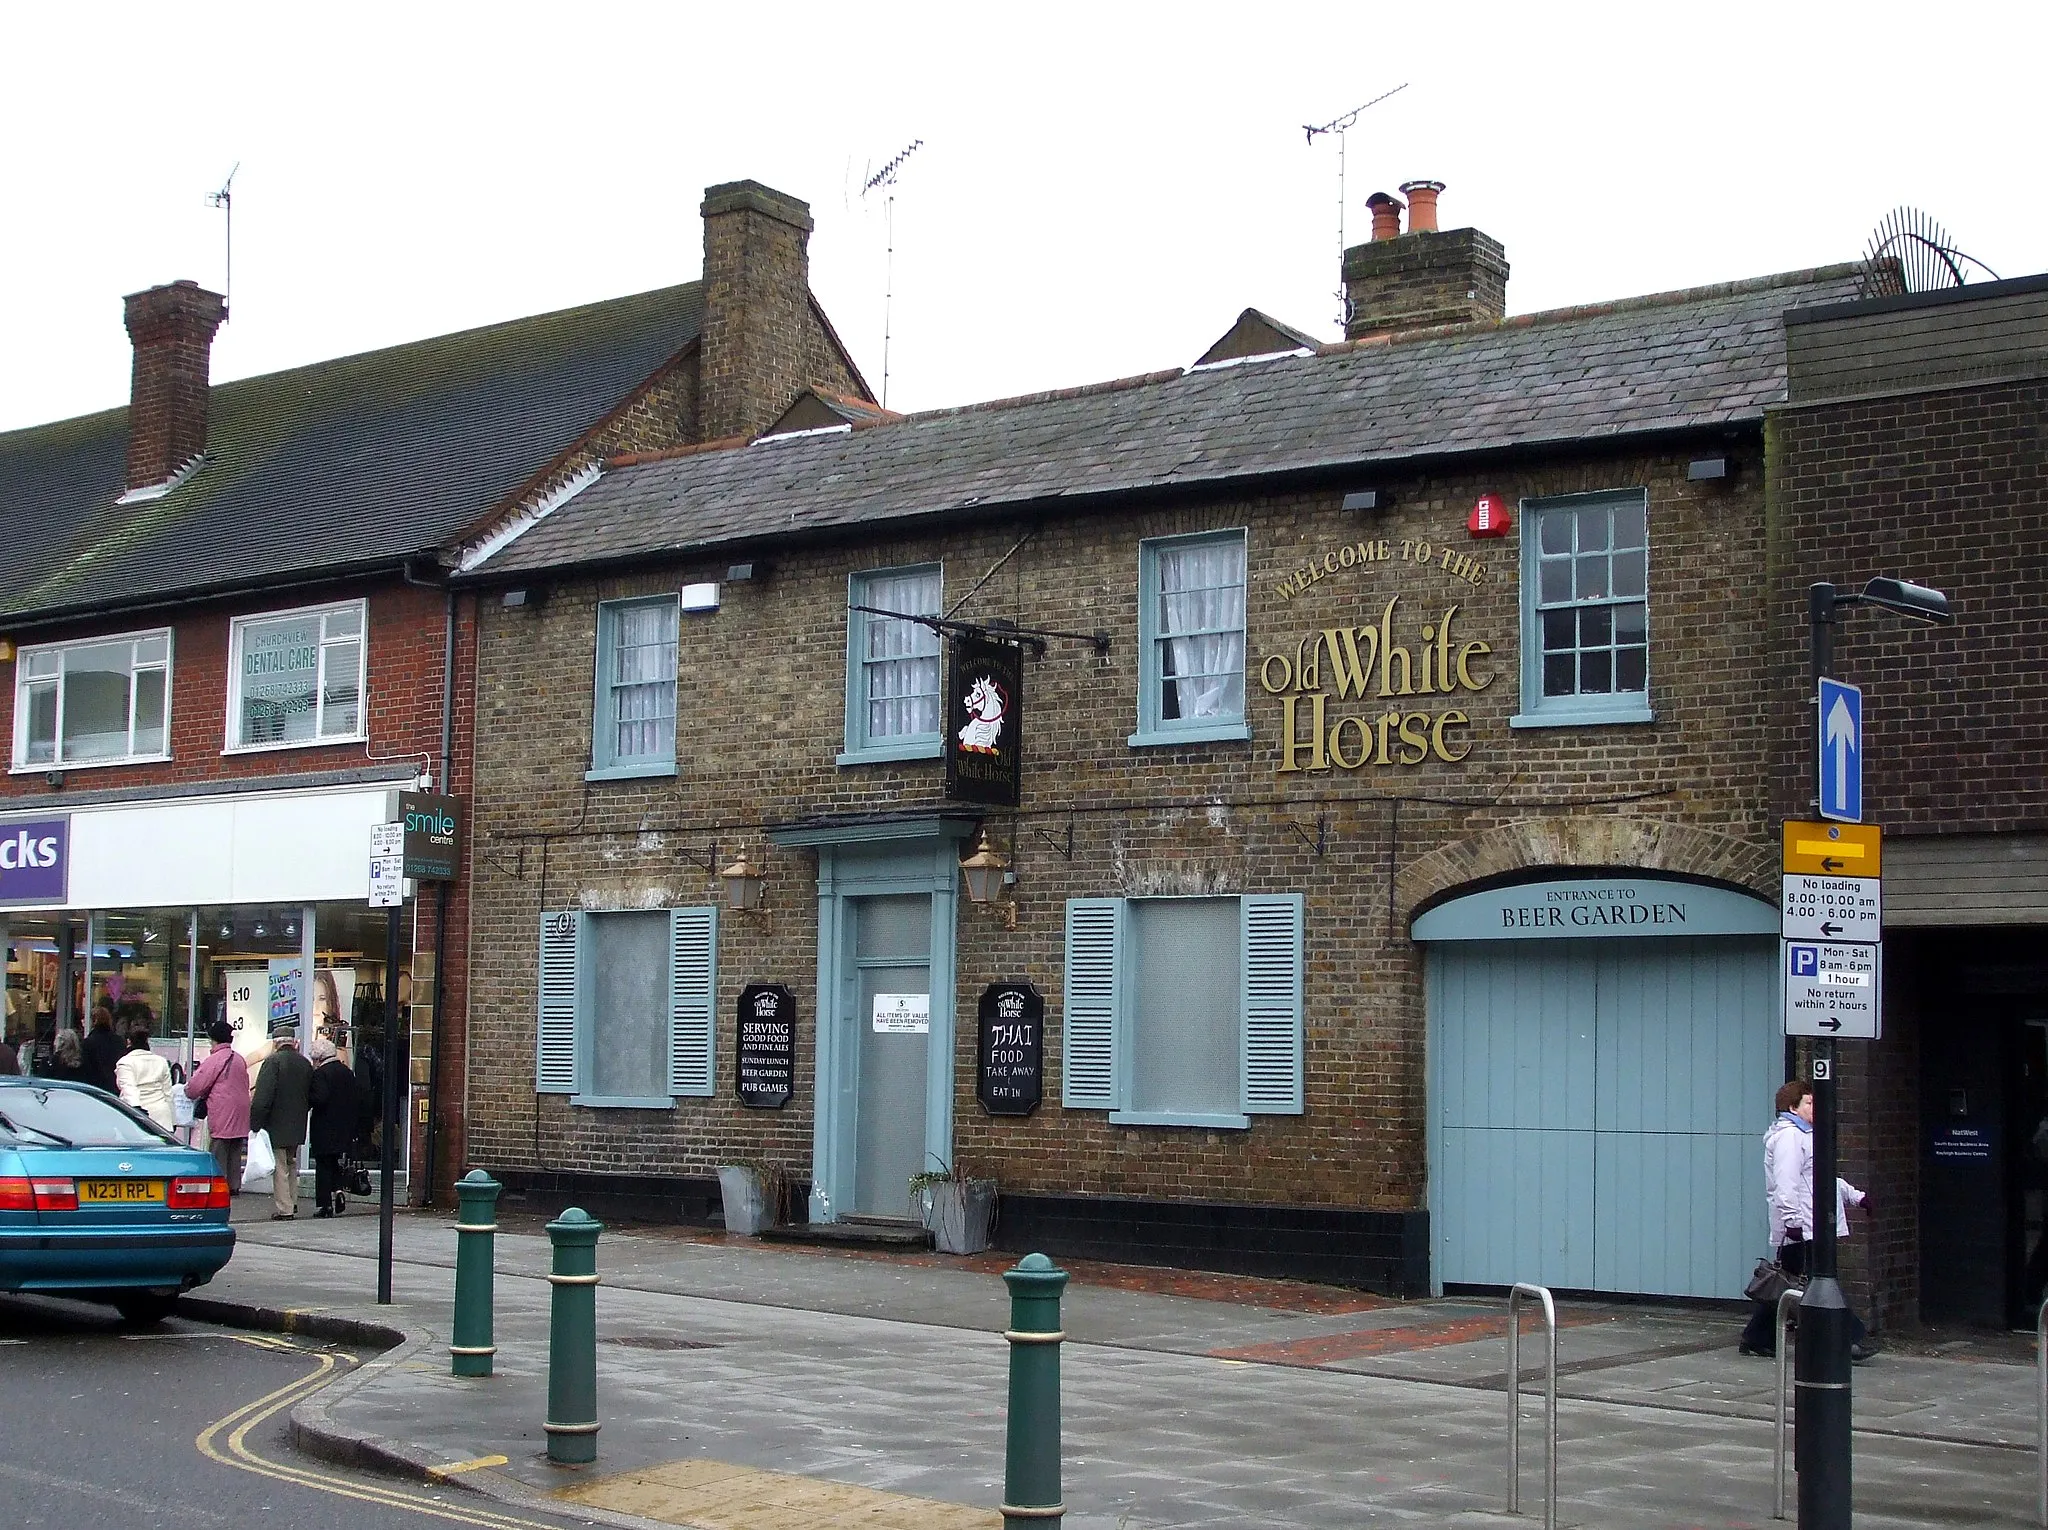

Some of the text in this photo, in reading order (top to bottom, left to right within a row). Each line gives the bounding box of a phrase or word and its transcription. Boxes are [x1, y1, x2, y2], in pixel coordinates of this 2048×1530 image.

[1274, 540, 1488, 601] WELCOME TO THE
[256, 630, 307, 647] CHURCHVIEW
[1261, 594, 1496, 700] Old White
[247, 646, 316, 675] DENTAL CARE
[250, 681, 308, 698] 01268 742333
[250, 703, 275, 717] 01268
[1278, 694, 1473, 772] Horse
[957, 757, 1012, 782] White Horse
[406, 808, 454, 835] smile
[430, 836, 453, 845] centre
[1803, 879, 1861, 893] No loading
[1546, 889, 1636, 902] ENTRANCE TO
[1859, 898, 1875, 906] am
[1502, 903, 1686, 928] BEER GARDEN
[1787, 907, 1815, 917] 4.00
[1828, 908, 1856, 919] 6.00
[1860, 911, 1877, 921] pm
[1824, 948, 1844, 957] Mon
[1852, 949, 1868, 958] Sat
[1797, 950, 1814, 974] P
[1828, 974, 1860, 984] 1 hour
[233, 987, 250, 1001] £10
[270, 984, 296, 1001] 20%
[1807, 989, 1855, 999] No return
[271, 997, 297, 1017] OFF
[761, 996, 778, 1008] White
[1005, 996, 1024, 1009] White
[1795, 1000, 1867, 1010] within 2 hours
[756, 1006, 775, 1016] Horse
[1000, 1006, 1021, 1018] Horse
[233, 1017, 244, 1030] £3
[743, 1022, 789, 1034] SERVING
[743, 1034, 789, 1042] GOOD FOOD
[991, 1024, 1032, 1049] THAI
[766, 1057, 788, 1065] LUNCH
[992, 1050, 1024, 1063] FOOD
[742, 1069, 788, 1077] BEER GARDEN
[986, 1066, 1034, 1077] TAKE AWAY
[1815, 1061, 1827, 1078] 9
[742, 1083, 788, 1093] PUB GAMES
[993, 1086, 1021, 1097] EAT IN
[88, 1183, 155, 1198] N231 RPL
